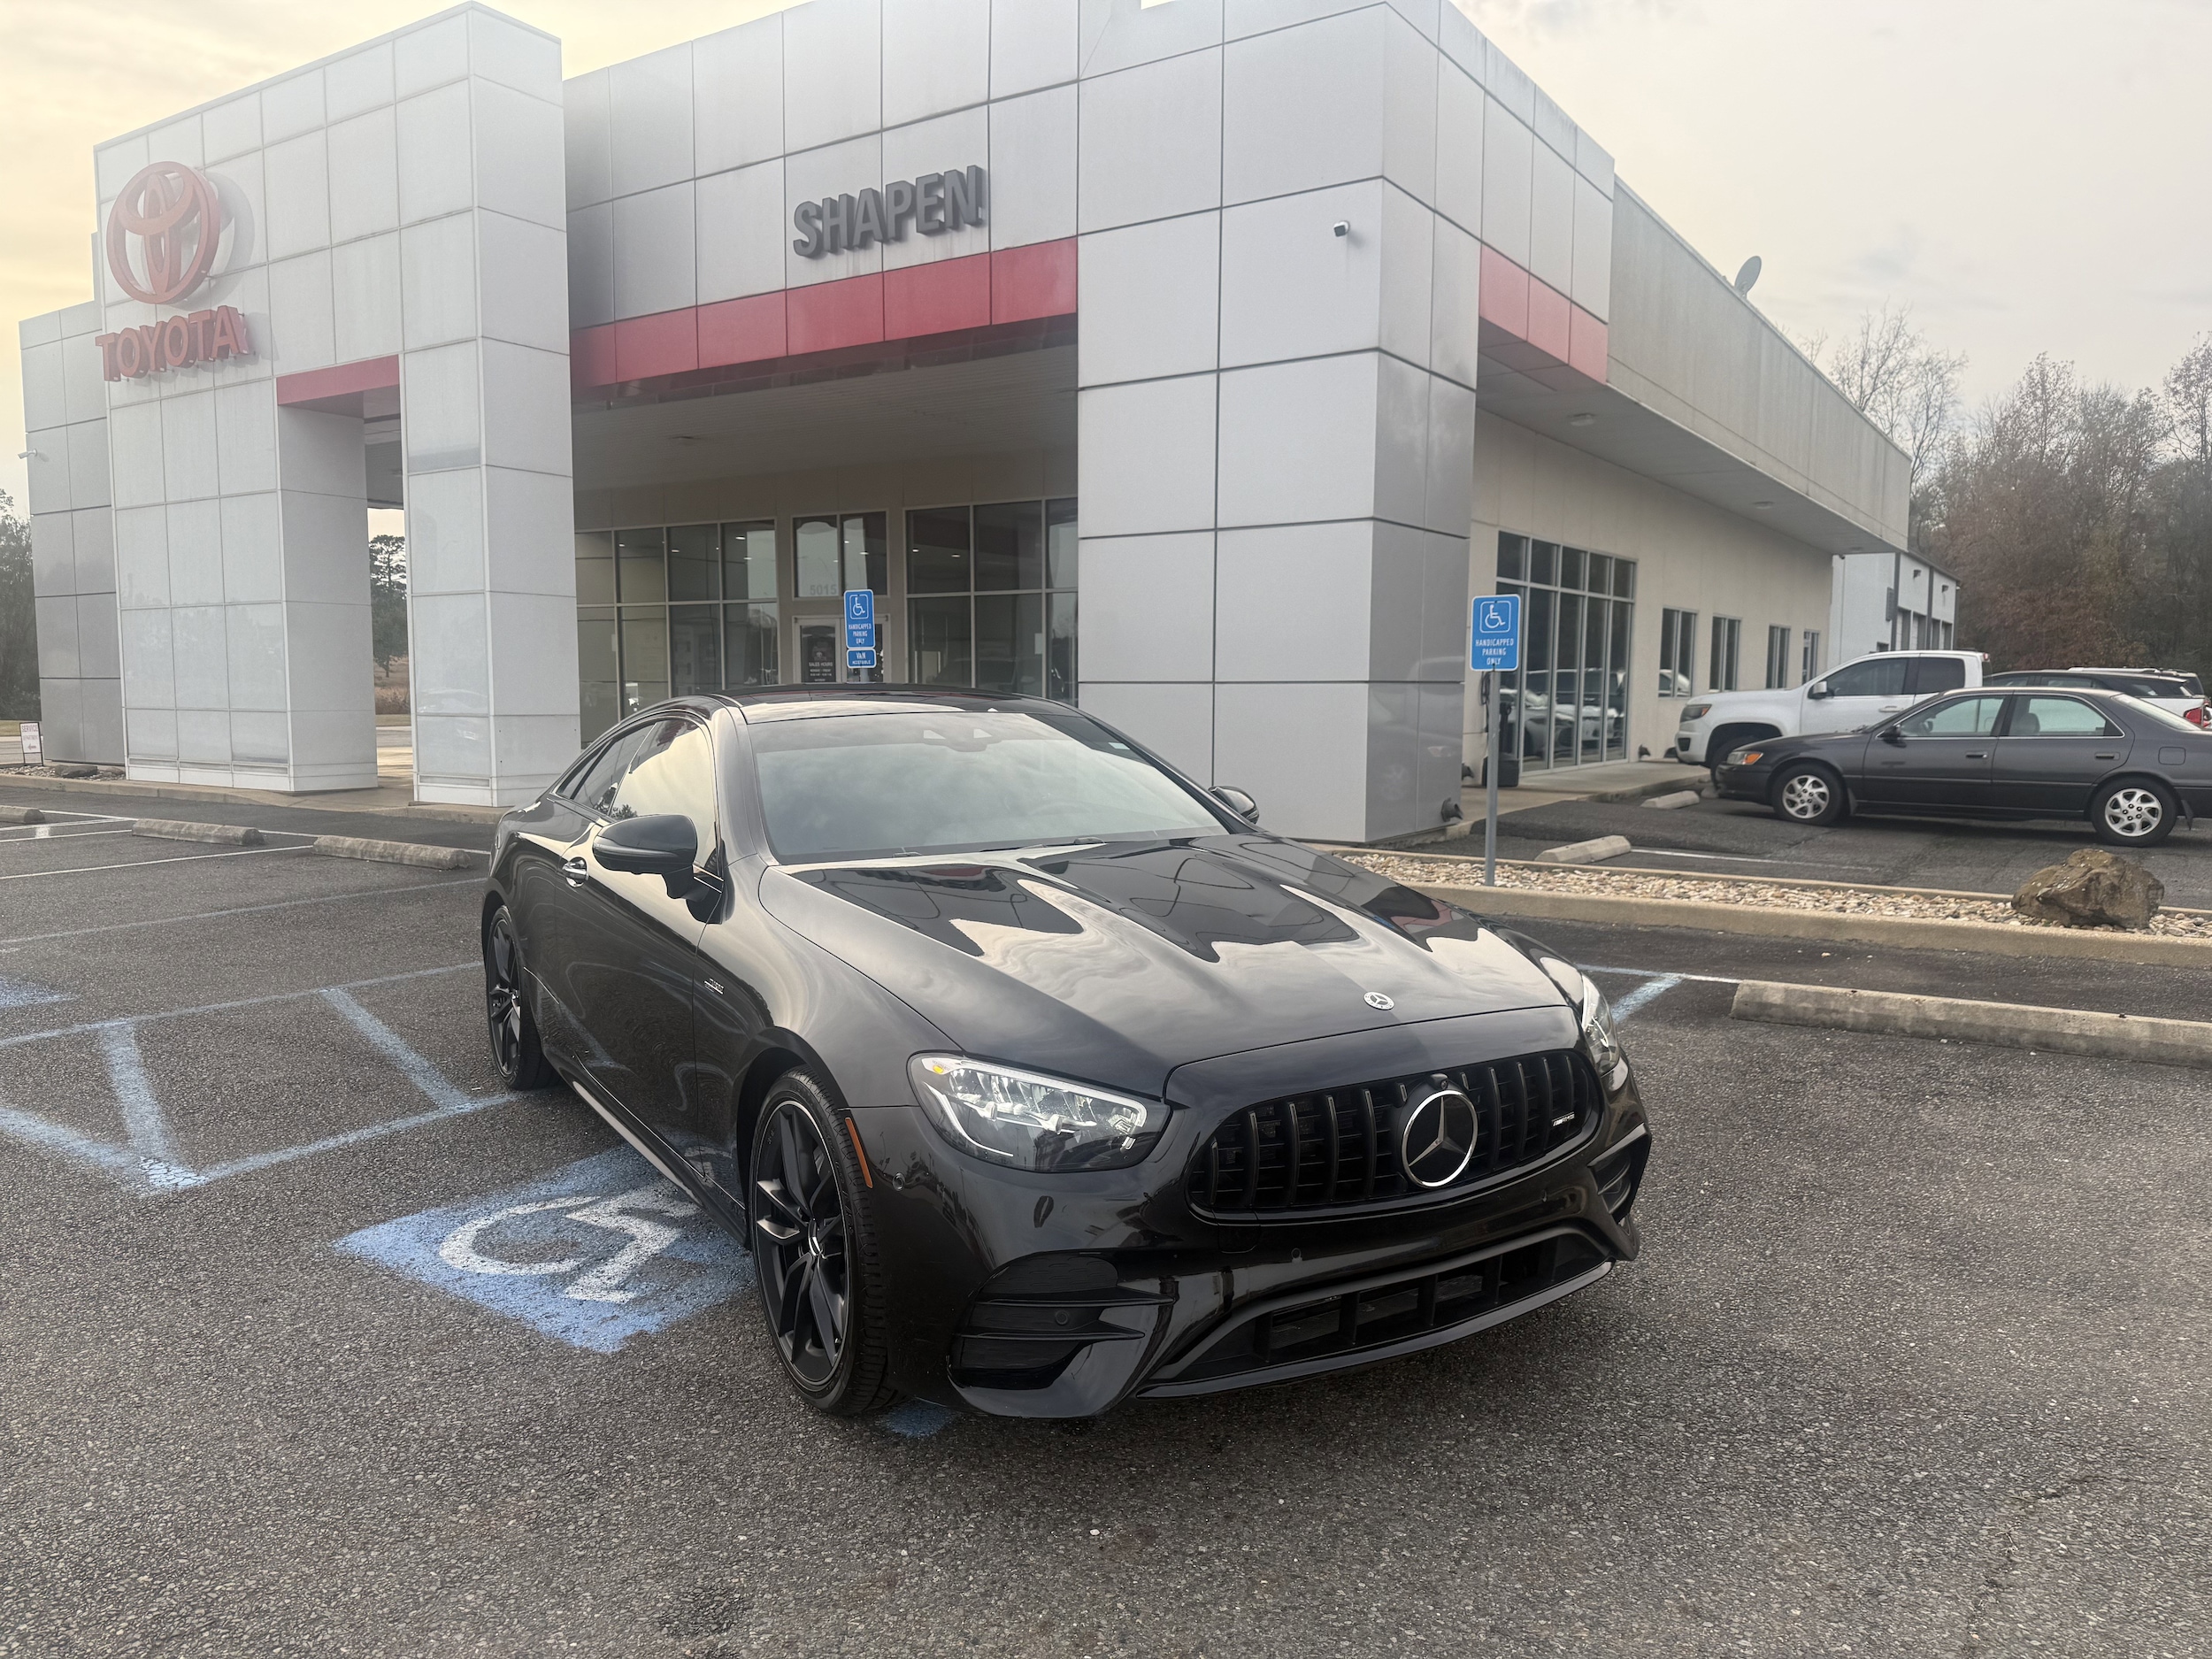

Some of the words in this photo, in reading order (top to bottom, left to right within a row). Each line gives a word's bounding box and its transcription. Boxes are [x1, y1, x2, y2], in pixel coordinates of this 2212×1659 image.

[794, 165, 985, 257] SHAPEN
[96, 305, 249, 381] TOYOTA
[810, 584, 836, 595] 5015
[1475, 638, 1514, 647] HANDICAPPED
[1482, 647, 1507, 656] PARKING
[1486, 657, 1502, 665] ONLY
